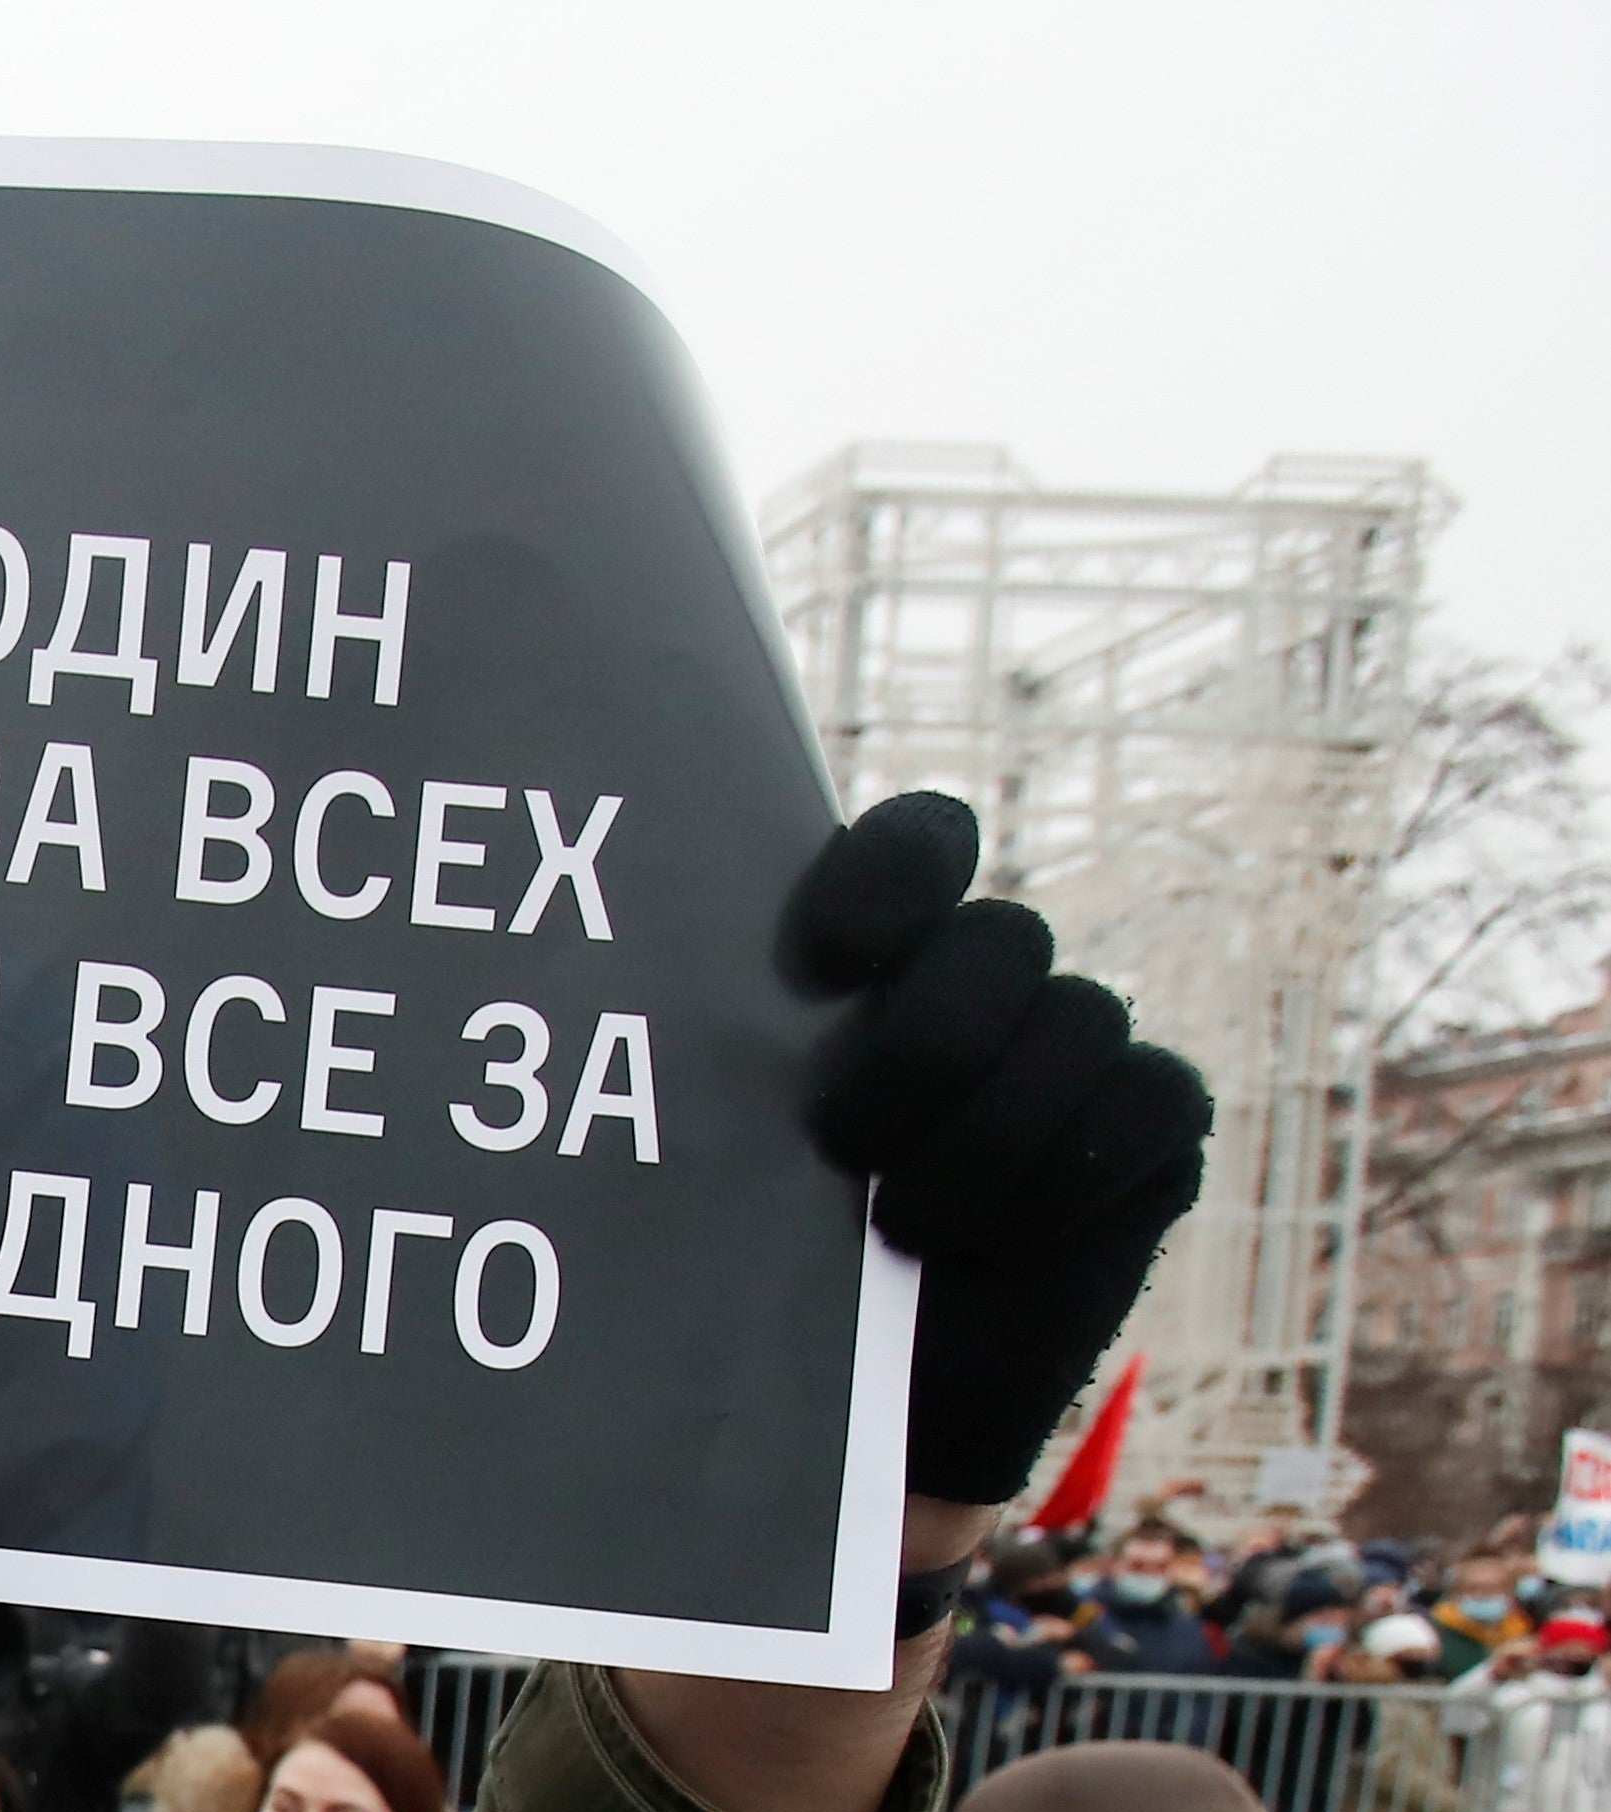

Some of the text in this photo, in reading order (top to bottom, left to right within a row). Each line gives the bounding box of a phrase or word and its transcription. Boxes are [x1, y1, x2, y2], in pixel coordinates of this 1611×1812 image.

[174, 755, 625, 942] ВСЕХ
[64, 959, 397, 1138] ВСЕ
[447, 1000, 661, 1165] ЗА
